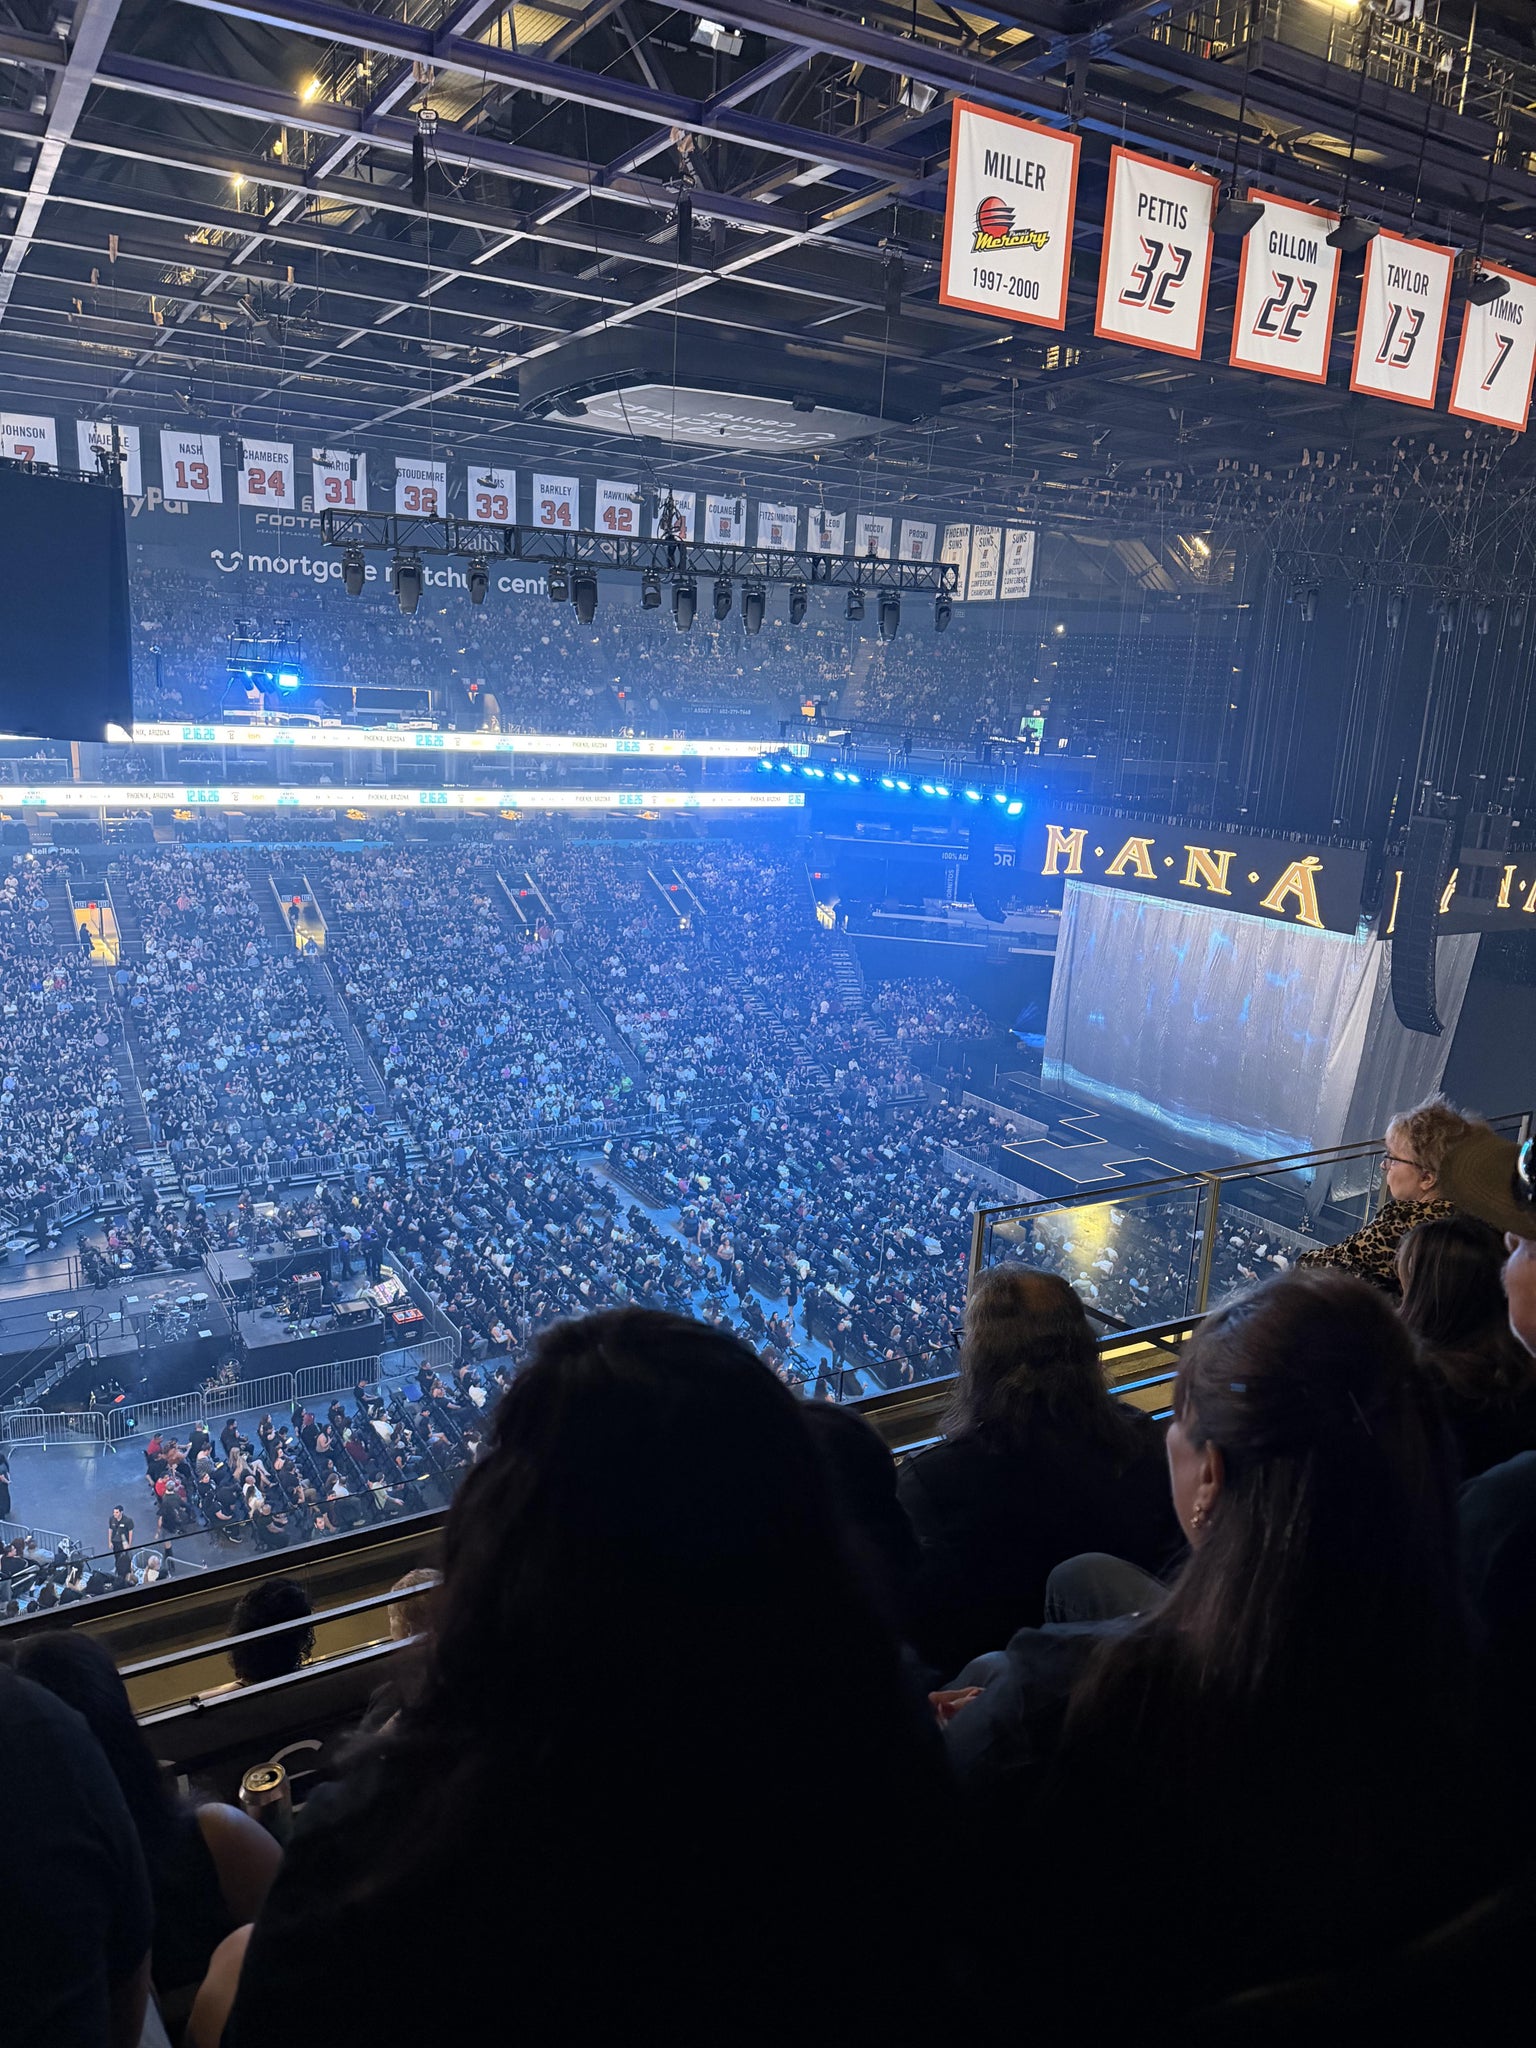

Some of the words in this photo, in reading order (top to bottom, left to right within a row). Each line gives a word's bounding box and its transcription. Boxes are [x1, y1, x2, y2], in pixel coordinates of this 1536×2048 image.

[984, 149, 1046, 191] MILLER
[1138, 192, 1188, 230] PETTIS
[975, 231, 1048, 249] Mercury
[1269, 230, 1318, 264] GILLOM
[972, 267, 1040, 301] 1997-2000
[1118, 234, 1192, 314] 32
[1387, 264, 1430, 296] TAYLOR
[1252, 270, 1318, 343] 22
[1375, 301, 1425, 369] 13
[1481, 331, 1514, 391] 7
[1, 424, 46, 439] JOHNSON
[88, 433, 130, 448] MAJEE
[179, 443, 203, 455] NASH
[243, 450, 289, 464] CHAMBERS
[175, 461, 209, 490] 13
[248, 468, 285, 496] 24
[397, 468, 445, 483] STOUDEMIRE
[325, 477, 356, 504] 31
[404, 485, 438, 513] 32
[540, 484, 572, 496] BARKLEY
[603, 490, 630, 502] HAWKIN
[476, 493, 509, 520] 33
[540, 500, 571, 527] 34
[603, 506, 632, 532] 42
[760, 511, 796, 524] FITZSIMMONS
[949, 540, 963, 549] SUNS
[979, 537, 994, 547] SUNS
[1012, 533, 1028, 544] SUNS
[248, 554, 377, 583] mortgae
[183, 727, 215, 741] 12.16.26
[187, 790, 219, 802] 12.16.26
